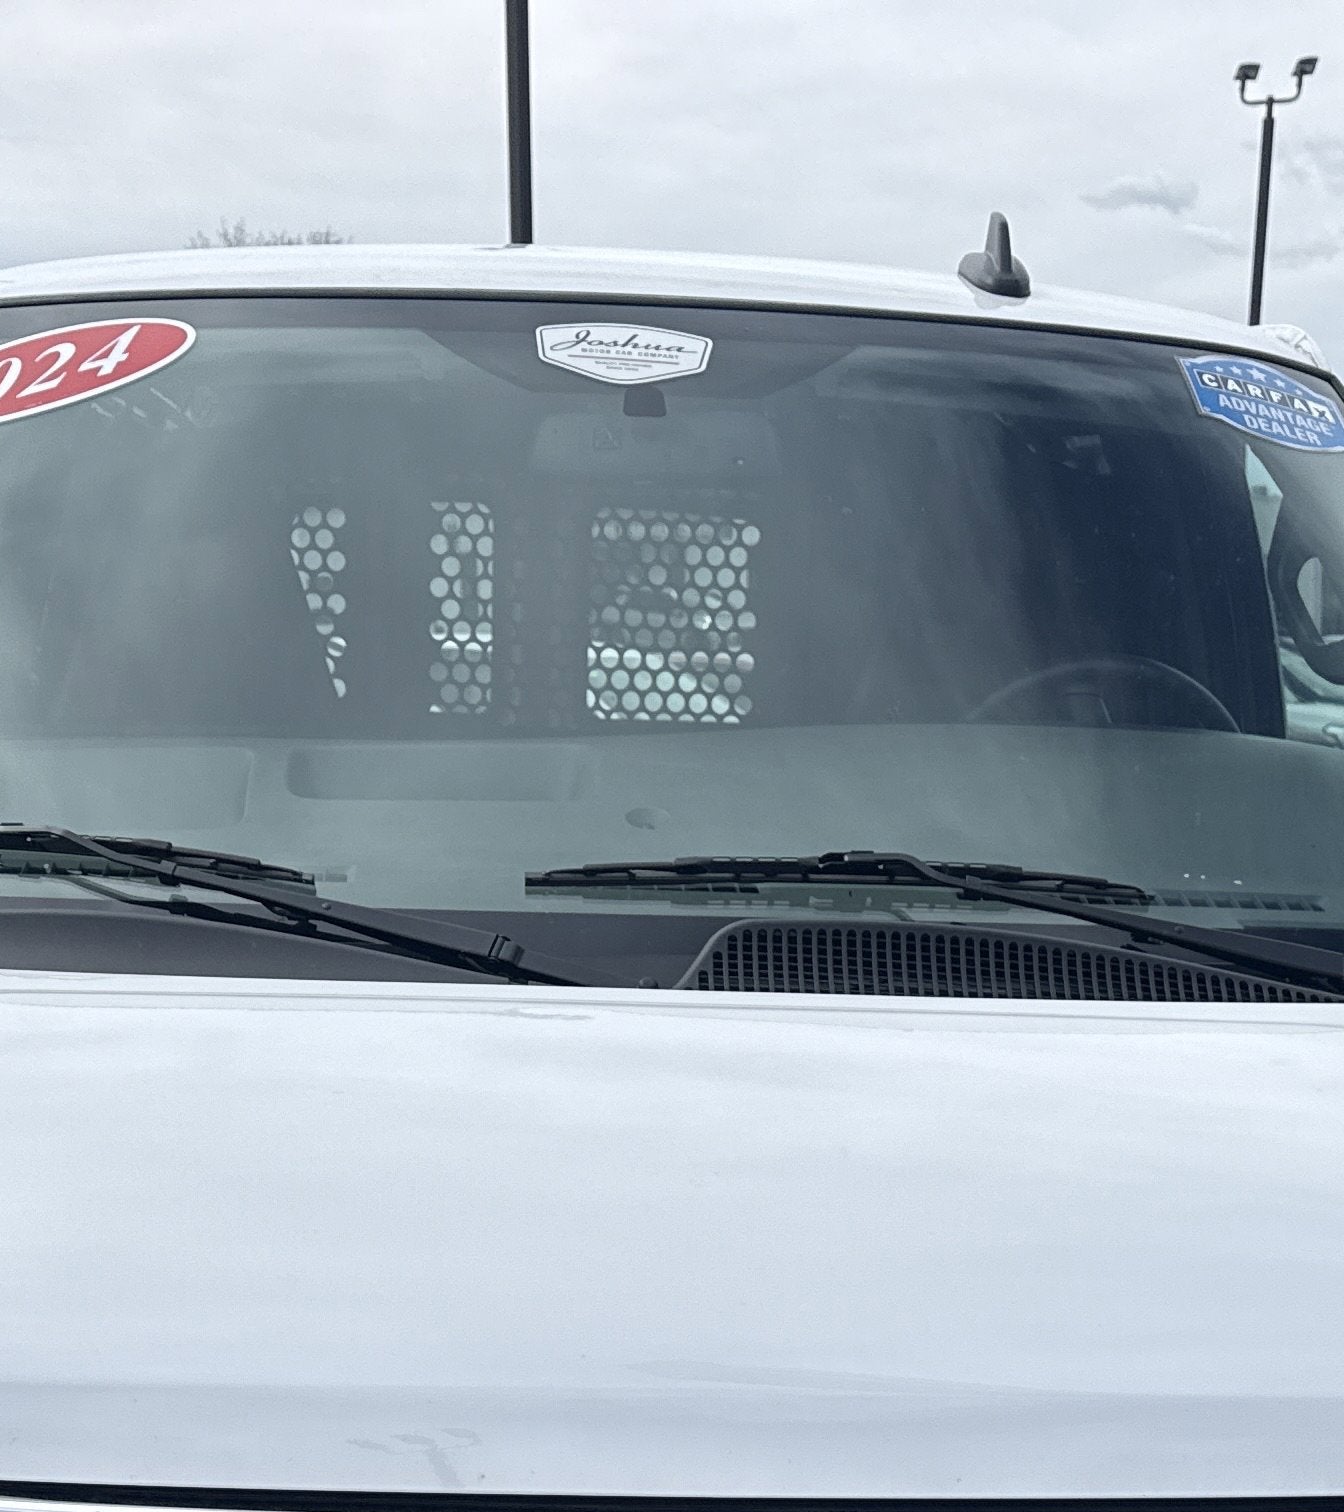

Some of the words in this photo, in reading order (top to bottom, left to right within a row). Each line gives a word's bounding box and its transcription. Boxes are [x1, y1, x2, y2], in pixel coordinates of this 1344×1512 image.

[550, 330, 698, 353] Joshua
[581, 347, 611, 355] MOTOR
[637, 351, 679, 360] COMPANY
[1218, 393, 1334, 437] ADVANTAGE
[1242, 413, 1322, 446] DEALER
